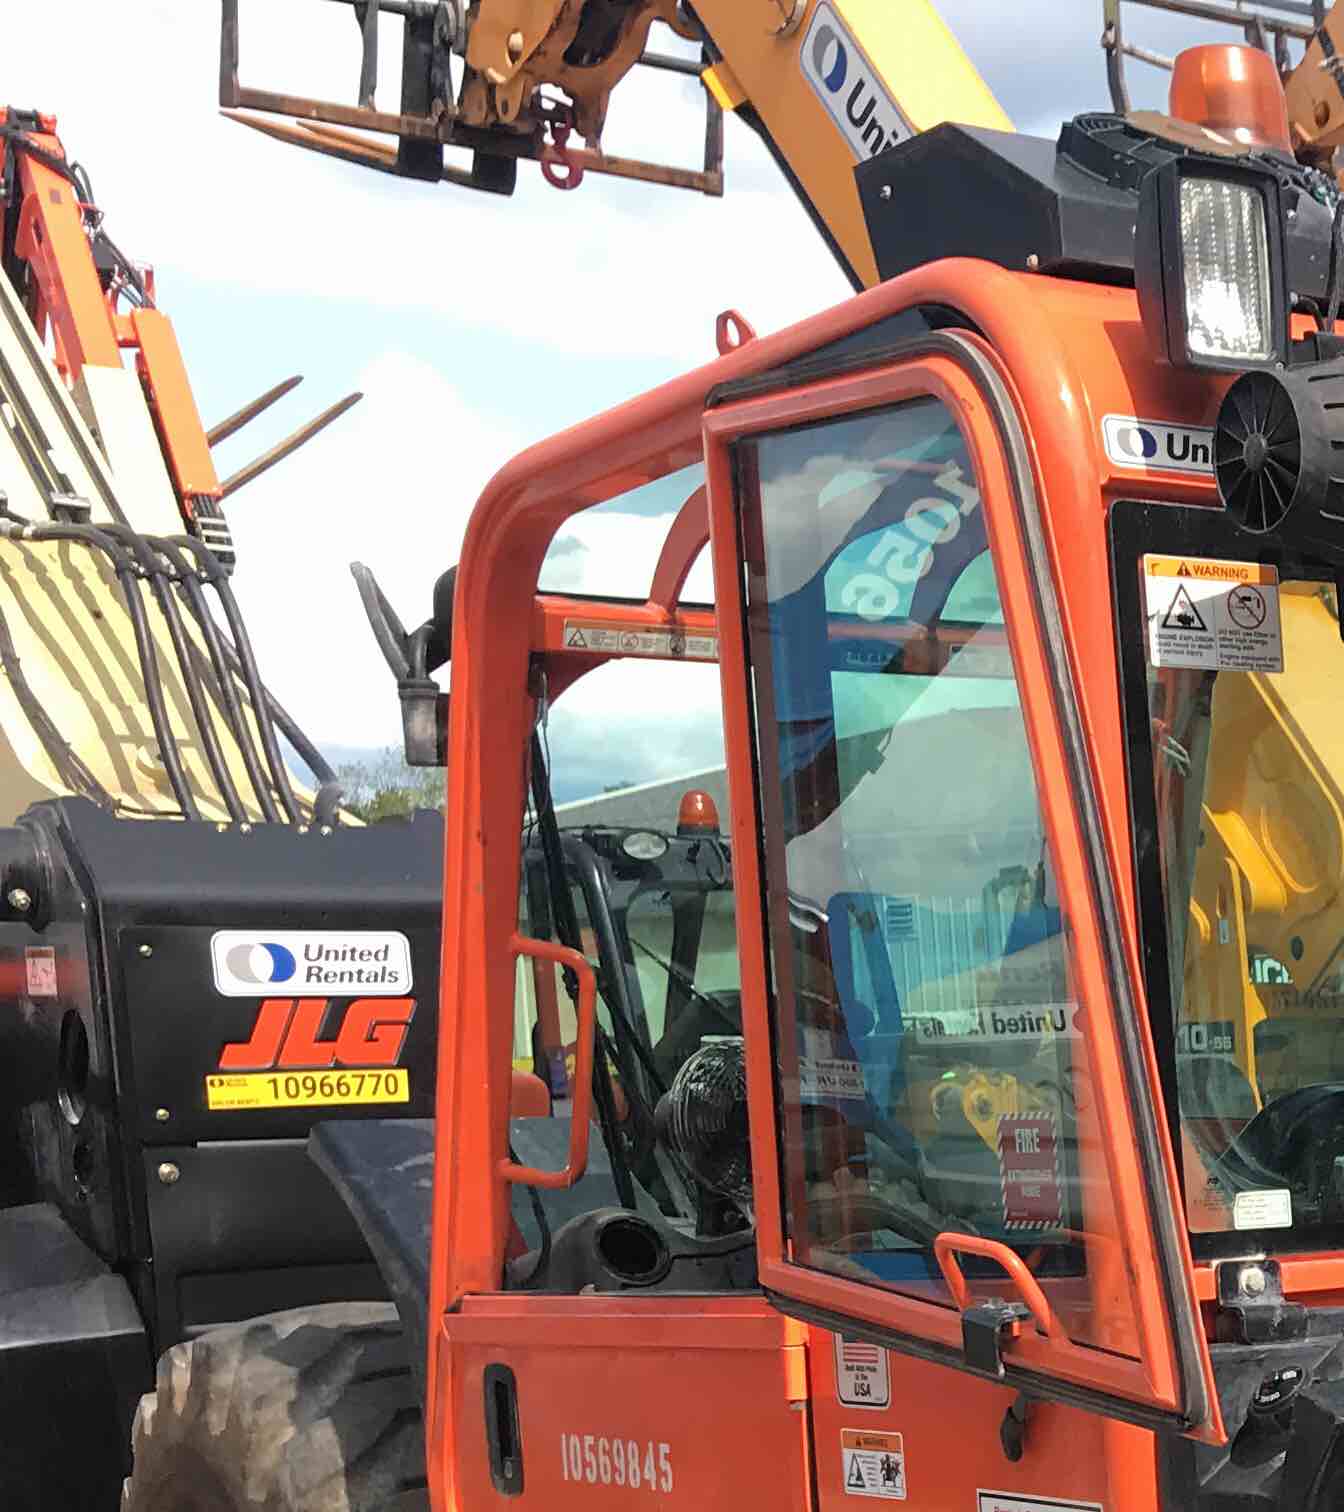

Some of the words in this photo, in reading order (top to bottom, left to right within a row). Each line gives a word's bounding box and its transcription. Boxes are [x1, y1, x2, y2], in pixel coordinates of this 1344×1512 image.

[1193, 564, 1249, 580] WARNING
[304, 943, 389, 962] United
[305, 966, 399, 984] Rentals
[219, 997, 417, 1070] JLG
[267, 1073, 398, 1100] 10966770
[854, 1382, 871, 1397] USA
[561, 1432, 673, 1493] 10569845
